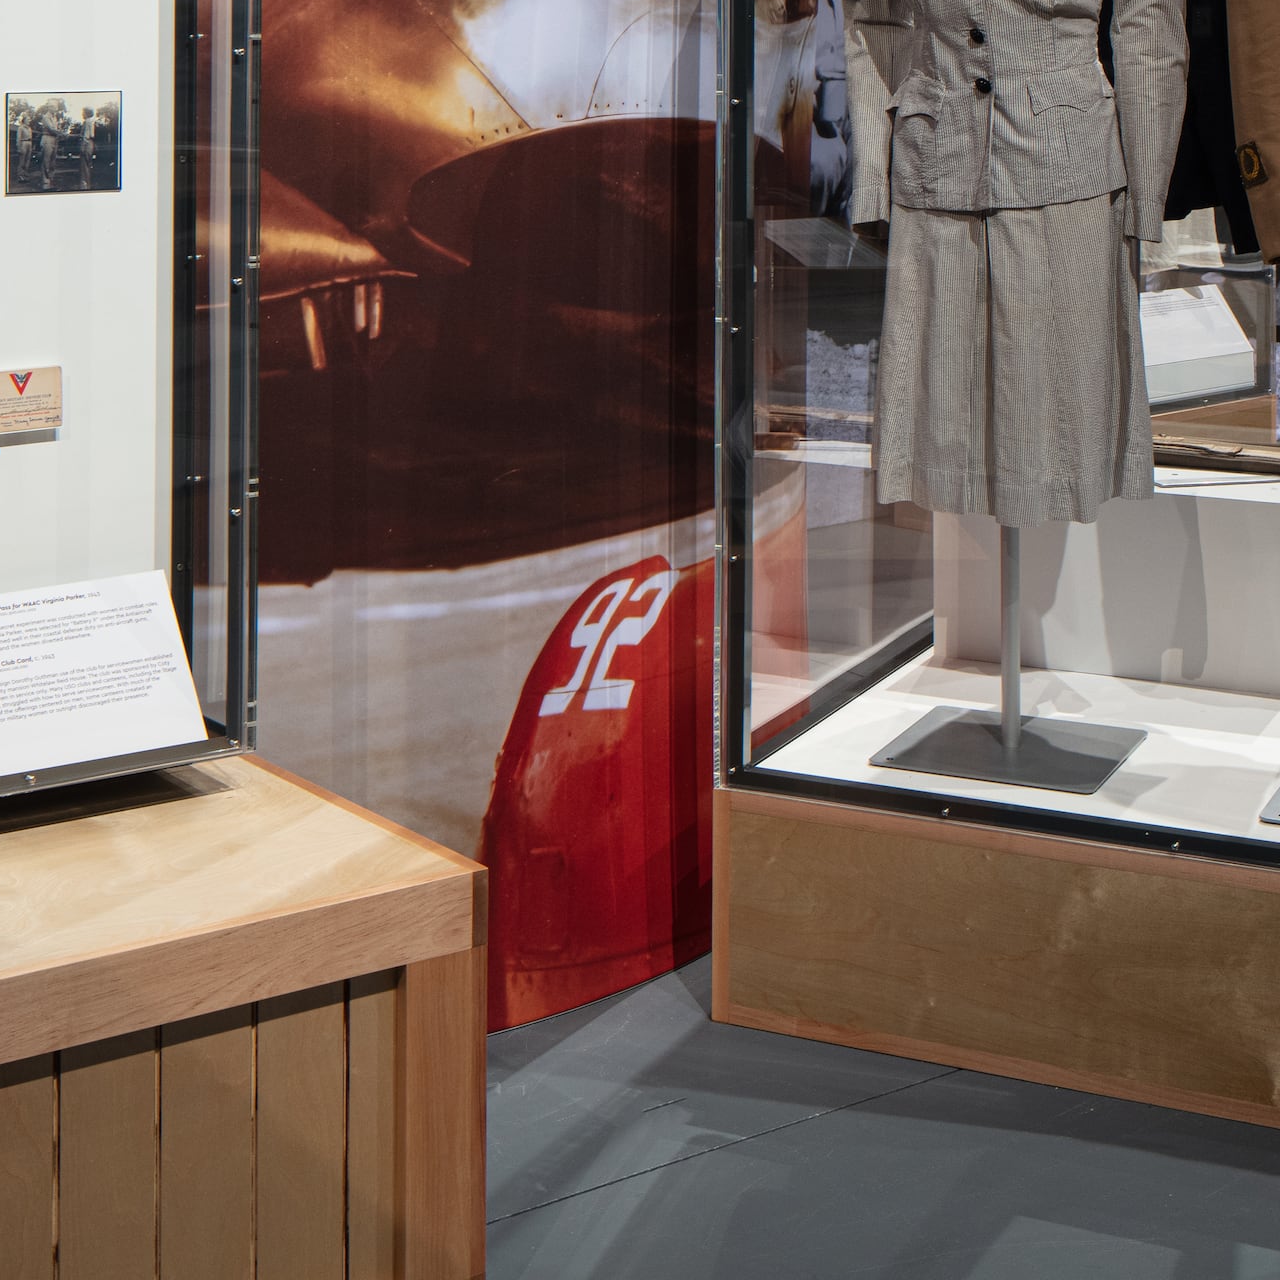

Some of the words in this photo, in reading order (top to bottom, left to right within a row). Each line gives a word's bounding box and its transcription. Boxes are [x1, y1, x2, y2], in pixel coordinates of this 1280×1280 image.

[22, 599, 40, 607] WAAC
[42, 595, 64, 605] Virginia
[538, 569, 680, 717] 92
[1, 658, 15, 666] Club
[16, 656, 33, 664] Card,
